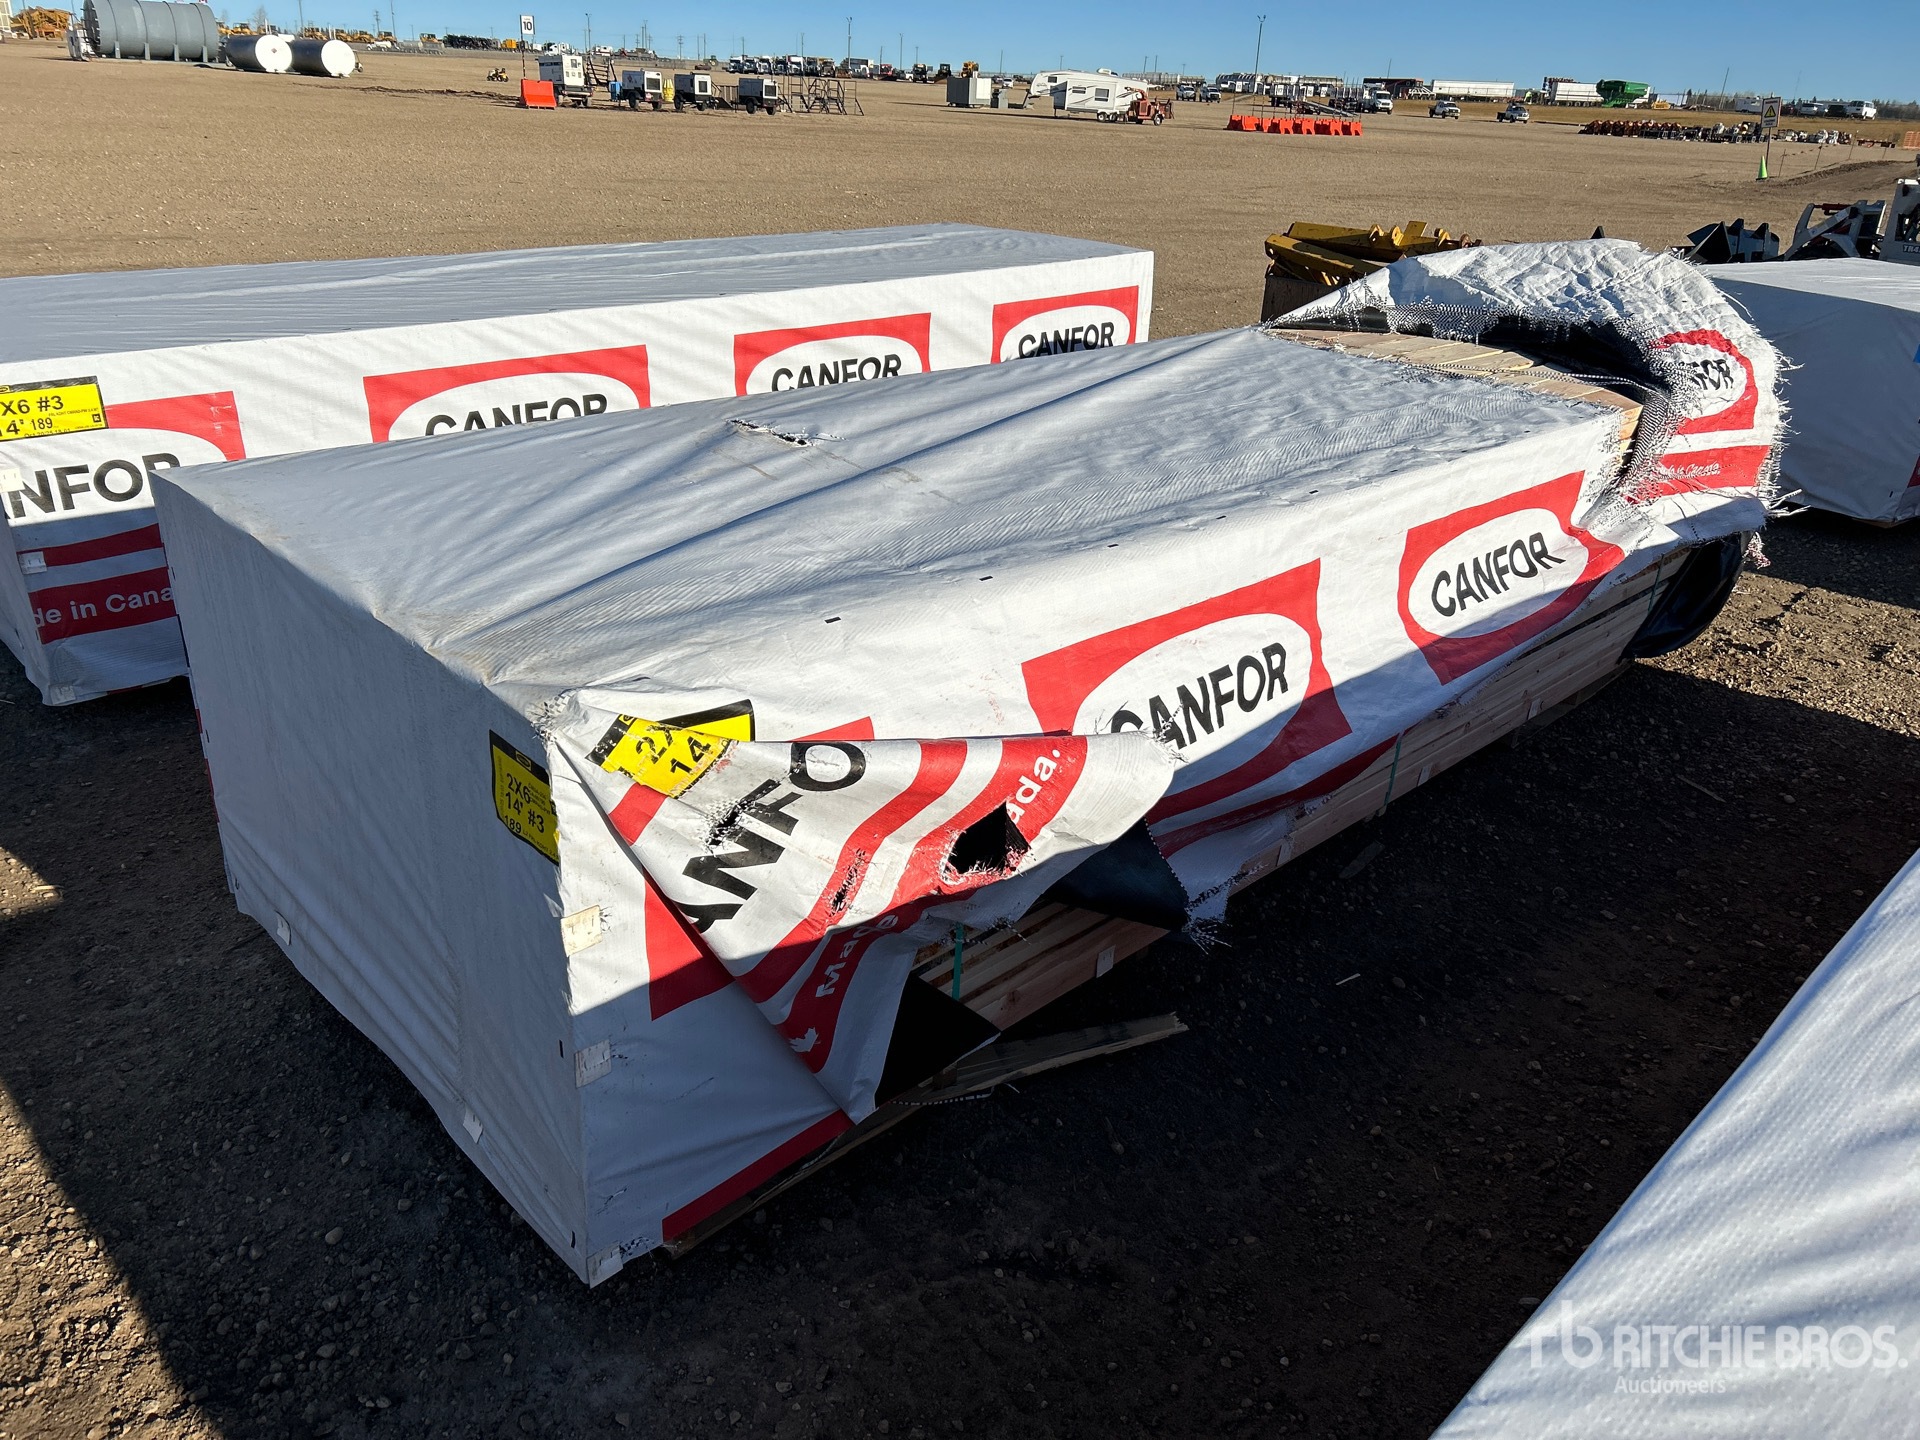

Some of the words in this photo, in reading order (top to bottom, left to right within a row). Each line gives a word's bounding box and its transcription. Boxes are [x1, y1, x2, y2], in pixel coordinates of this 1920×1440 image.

[523, 21, 533, 31] 10
[1018, 322, 1114, 359] CANFOR
[771, 354, 902, 392] CANFOR
[36, 396, 64, 412] #3
[31, 418, 53, 431] 189
[1431, 532, 1566, 617] CANFOR
[70, 601, 97, 620] in
[506, 773, 531, 804] 2X6
[505, 791, 523, 815] 14'
[528, 808, 545, 833] #3
[505, 815, 521, 834] 189
